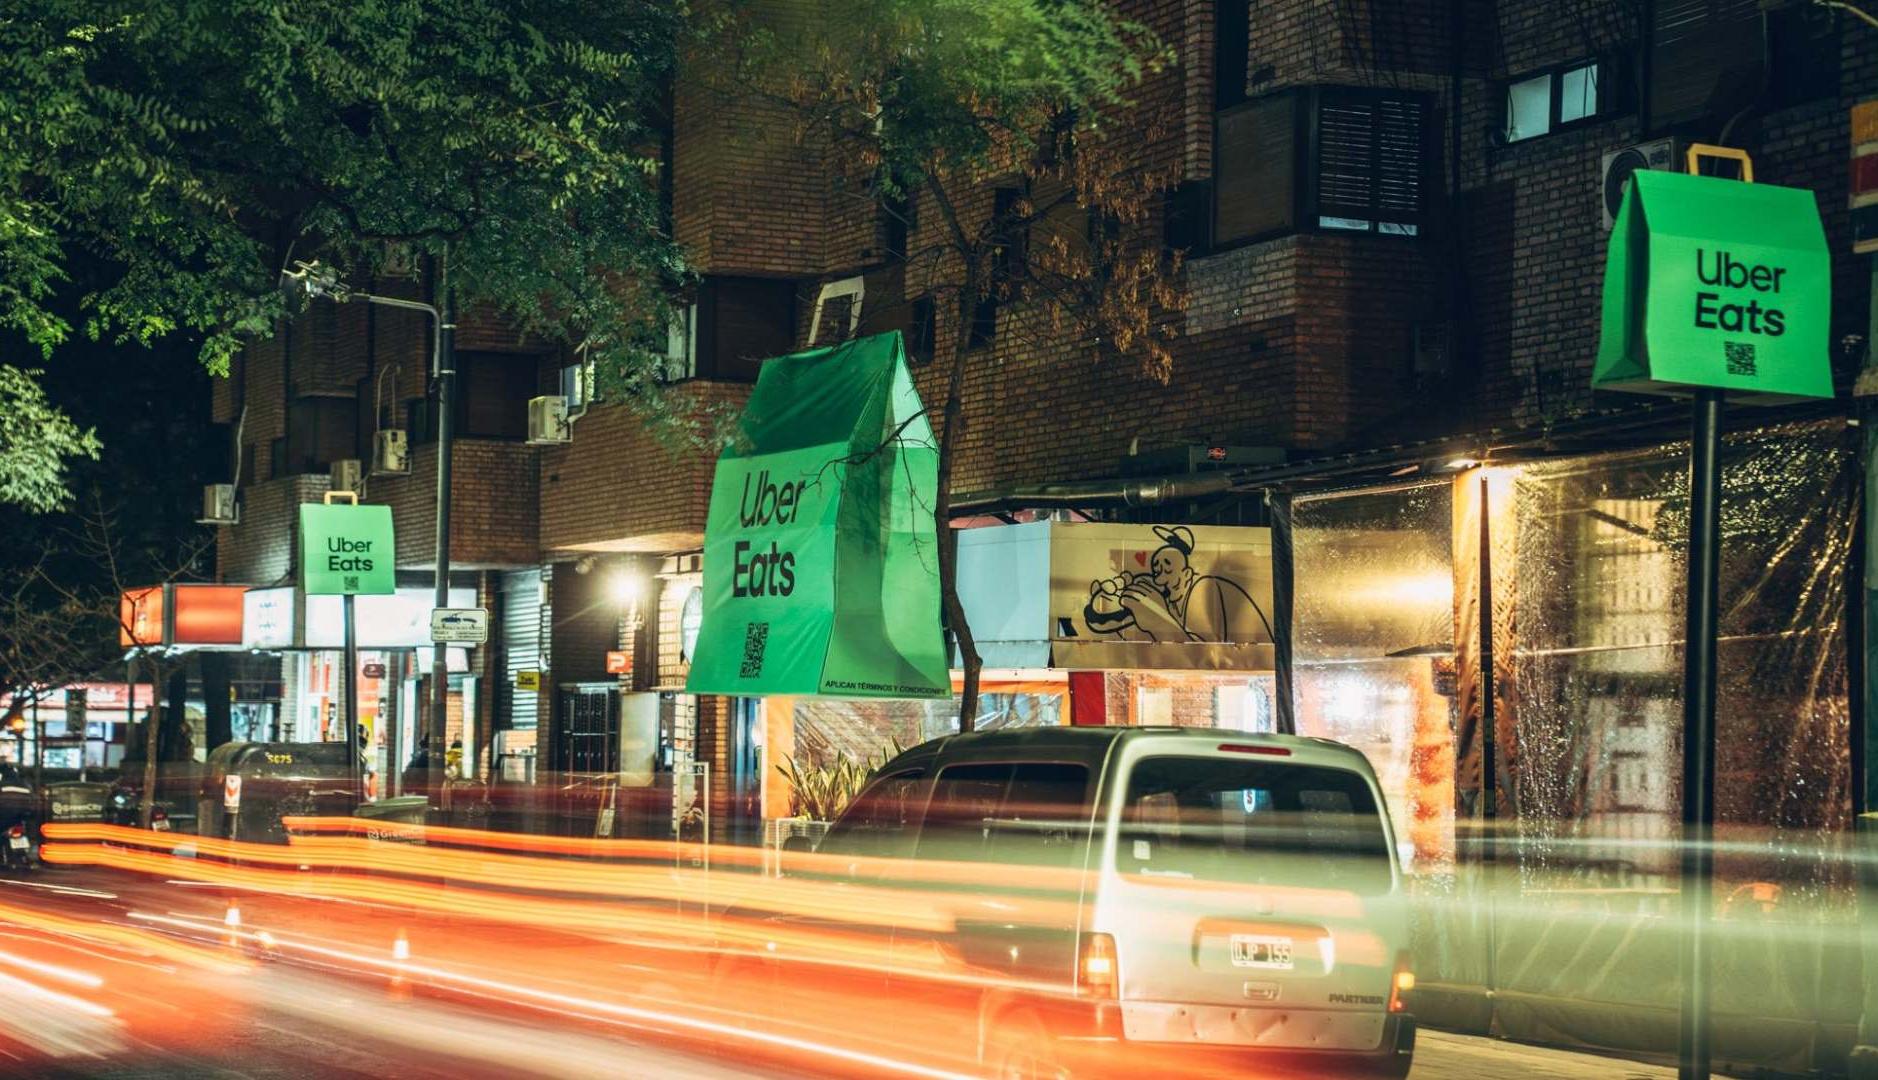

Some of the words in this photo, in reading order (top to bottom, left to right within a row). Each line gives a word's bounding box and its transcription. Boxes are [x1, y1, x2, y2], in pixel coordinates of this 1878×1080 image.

[1697, 248, 1786, 293] Uber
[1695, 291, 1786, 337] Eats
[741, 470, 805, 528] Uber
[328, 537, 372, 553] Uber
[328, 556, 374, 571] Eats
[733, 540, 796, 598] Eats
[825, 680, 856, 689] APLICAN
[1267, 944, 1292, 964] 155
[1328, 993, 1384, 1005] PARTNER
